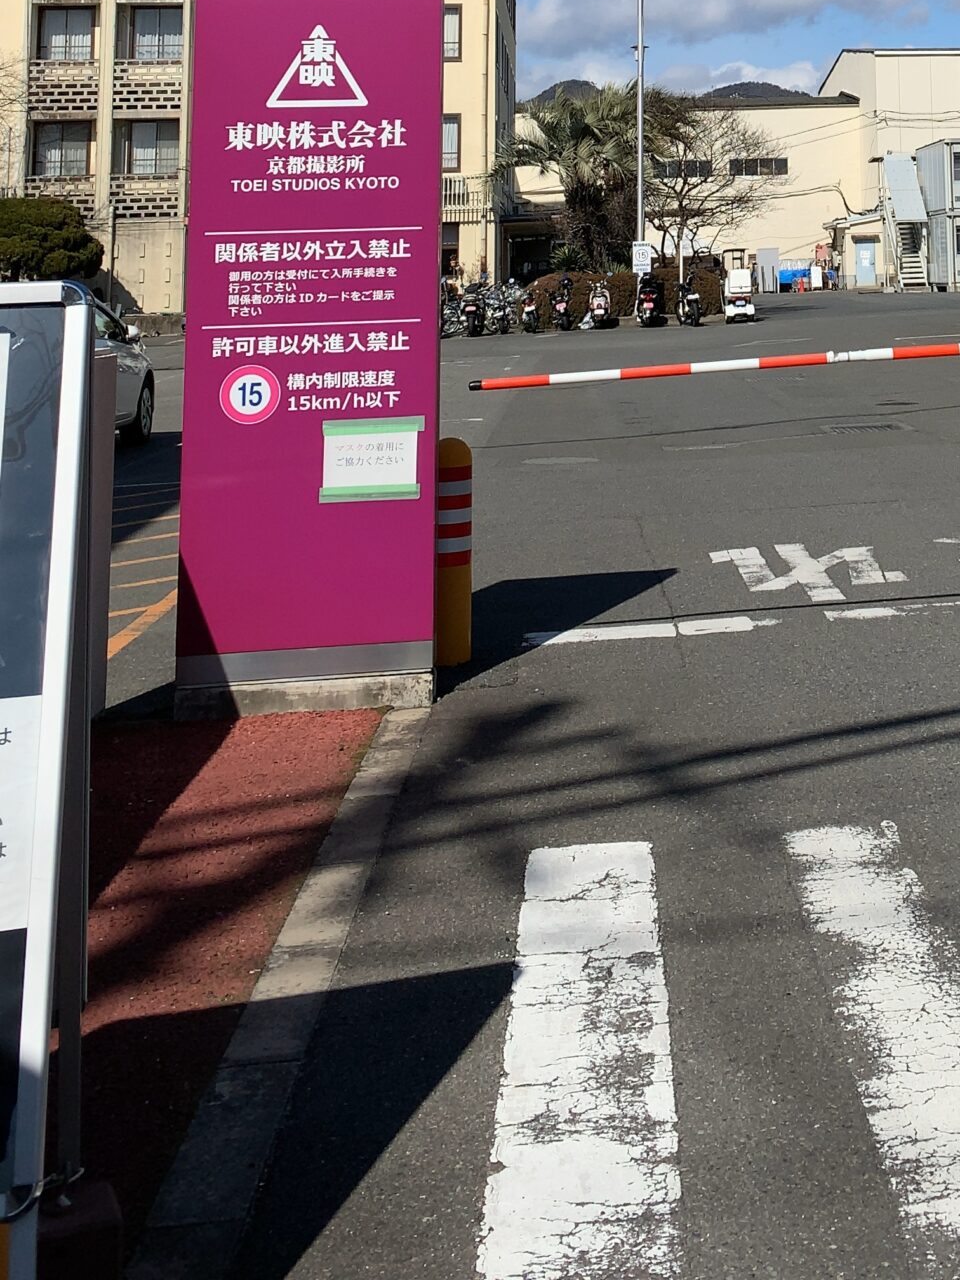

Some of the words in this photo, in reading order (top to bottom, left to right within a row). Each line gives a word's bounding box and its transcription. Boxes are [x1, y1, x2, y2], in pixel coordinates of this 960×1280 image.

[299, 37, 336, 87] 東映
[224, 118, 408, 151] 東映株式会社
[265, 154, 366, 175] 京都撮影所
[231, 179, 267, 192] TOEI
[272, 178, 340, 191] STUDIOS
[345, 176, 400, 190] KYOTO
[214, 238, 412, 264] 関係者以外立入禁止
[638, 251, 647, 259] 15
[228, 267, 398, 282] 御用の方は受付にて入所手続きを
[228, 281, 297, 294] 行って下さい
[228, 306, 263, 318] 下さい
[212, 331, 410, 358] 許可車以外進入禁止
[286, 369, 396, 391] 構内制限速度
[237, 382, 263, 408] 15
[287, 390, 401, 412] 15km/h以下
[335, 441, 405, 452] マスクの着用に
[335, 455, 405, 467] ご協力ください
